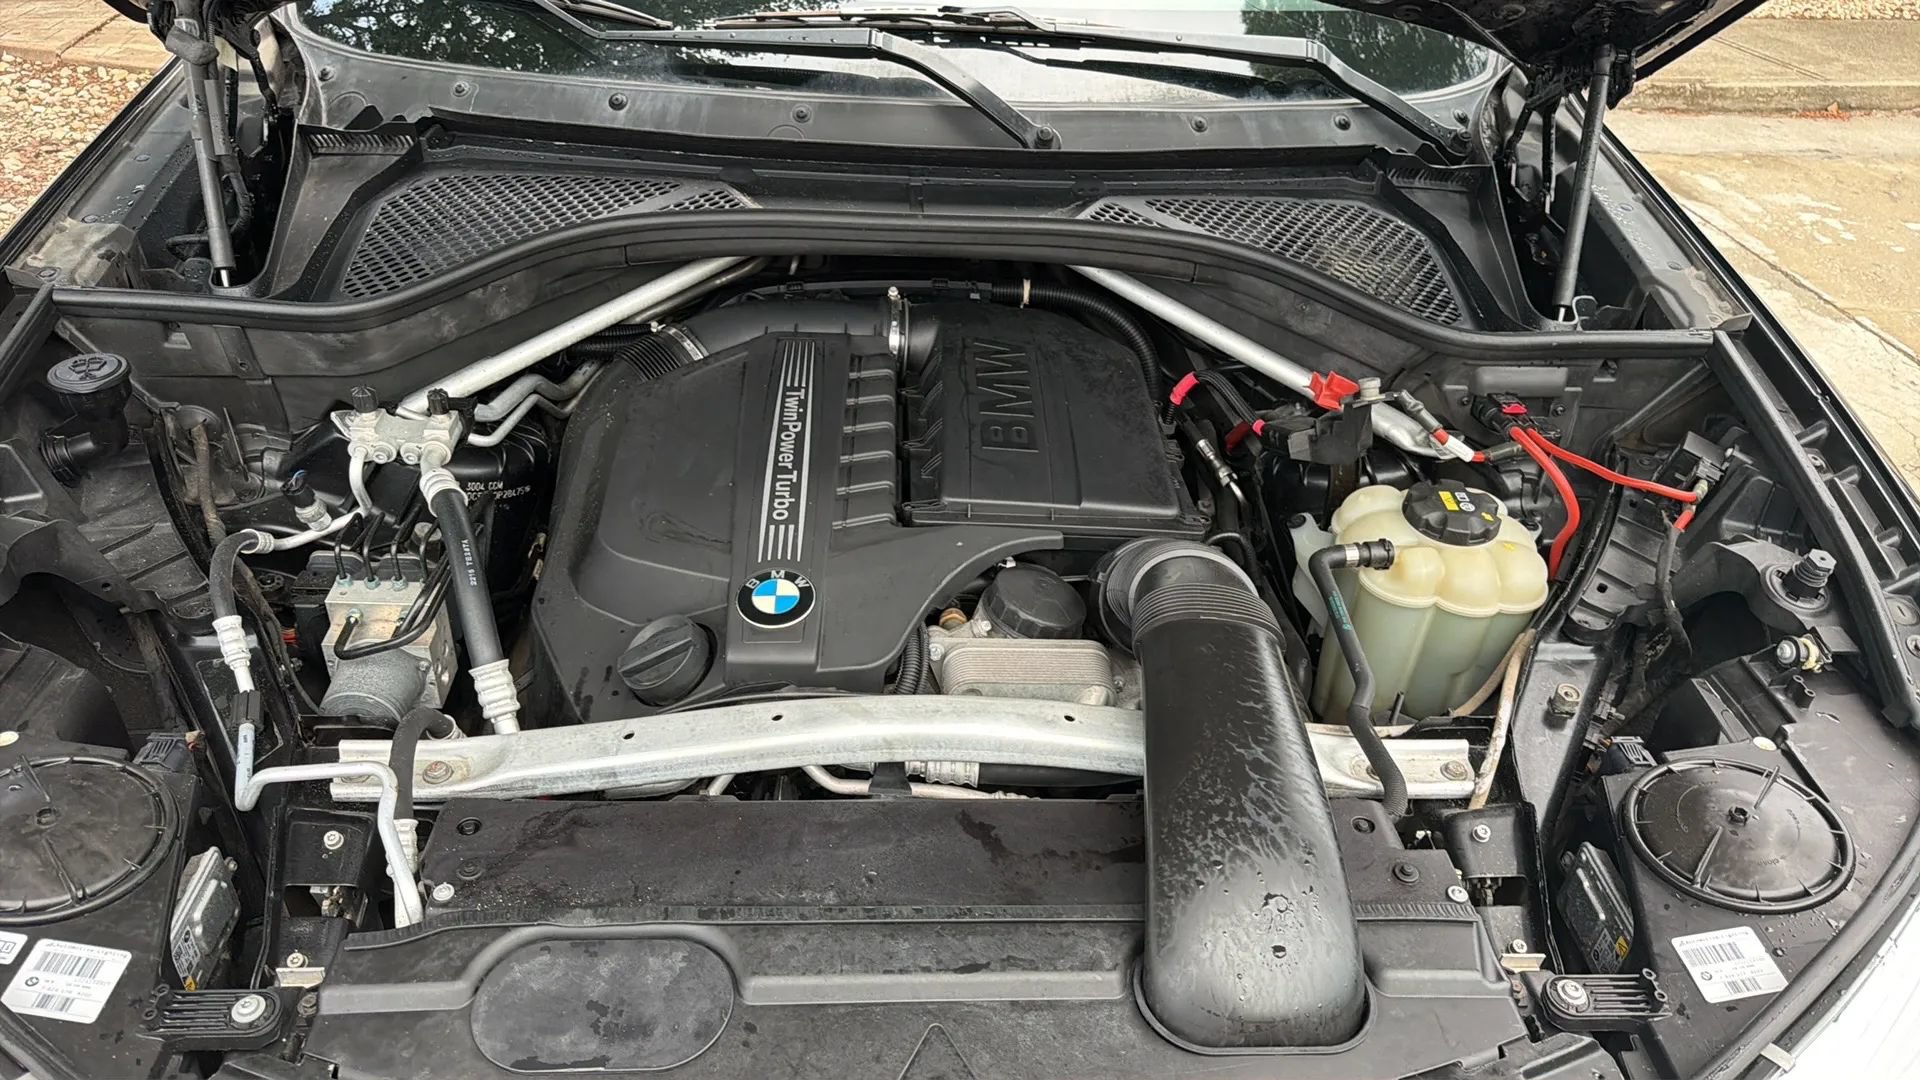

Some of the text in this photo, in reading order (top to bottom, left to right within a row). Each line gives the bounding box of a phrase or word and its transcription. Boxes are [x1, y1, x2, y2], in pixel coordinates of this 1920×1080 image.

[973, 341, 1040, 453] BMW
[771, 388, 806, 521] TwinPower Turbo
[745, 569, 811, 590] BMW
